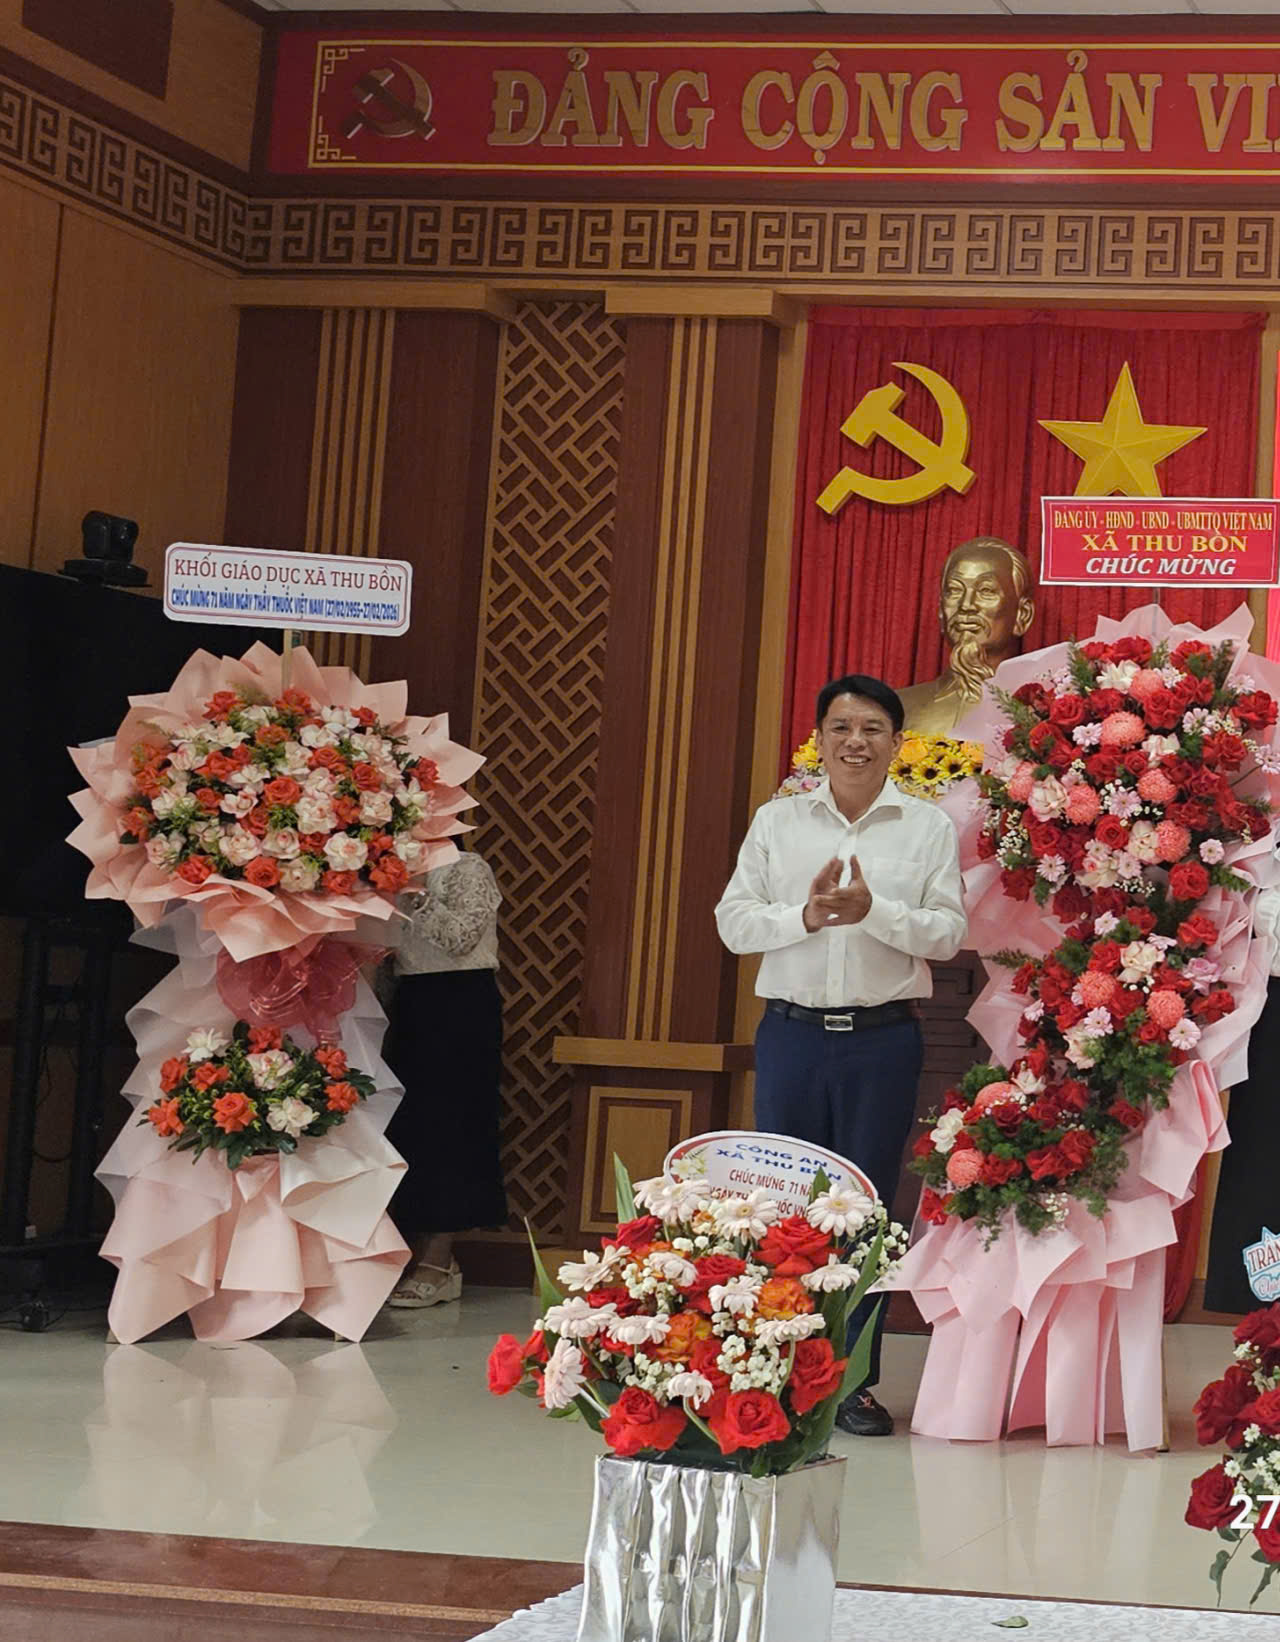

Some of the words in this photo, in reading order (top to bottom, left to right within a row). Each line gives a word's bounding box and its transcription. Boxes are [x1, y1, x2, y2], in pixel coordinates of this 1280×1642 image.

[487, 48, 714, 149] ĐẢNG
[741, 50, 967, 165] CỘNG
[995, 49, 1162, 151] SẢN
[1105, 510, 1134, 529] HĐND
[1142, 511, 1170, 530] UBND
[1248, 512, 1273, 531] NAM
[1081, 530, 1119, 552] XÃ
[1126, 534, 1183, 552] THU
[174, 552, 217, 578] KHỐI
[221, 560, 262, 581] GIÁO
[266, 566, 300, 588] DỤC
[304, 567, 327, 586] XÃ
[330, 571, 365, 589] THU
[368, 565, 403, 592] BỒN
[1086, 553, 1154, 575] CHÚC
[1156, 554, 1237, 576] MỪNG
[171, 583, 190, 606] CHÚC
[210, 591, 218, 608] 71
[308, 598, 324, 616] NAM
[735, 1143, 793, 1160] CÔNG
[799, 1156, 828, 1168] AN
[751, 1156, 794, 1170] THU
[729, 1168, 753, 1185] CHÚC
[789, 1180, 798, 1195] 71
